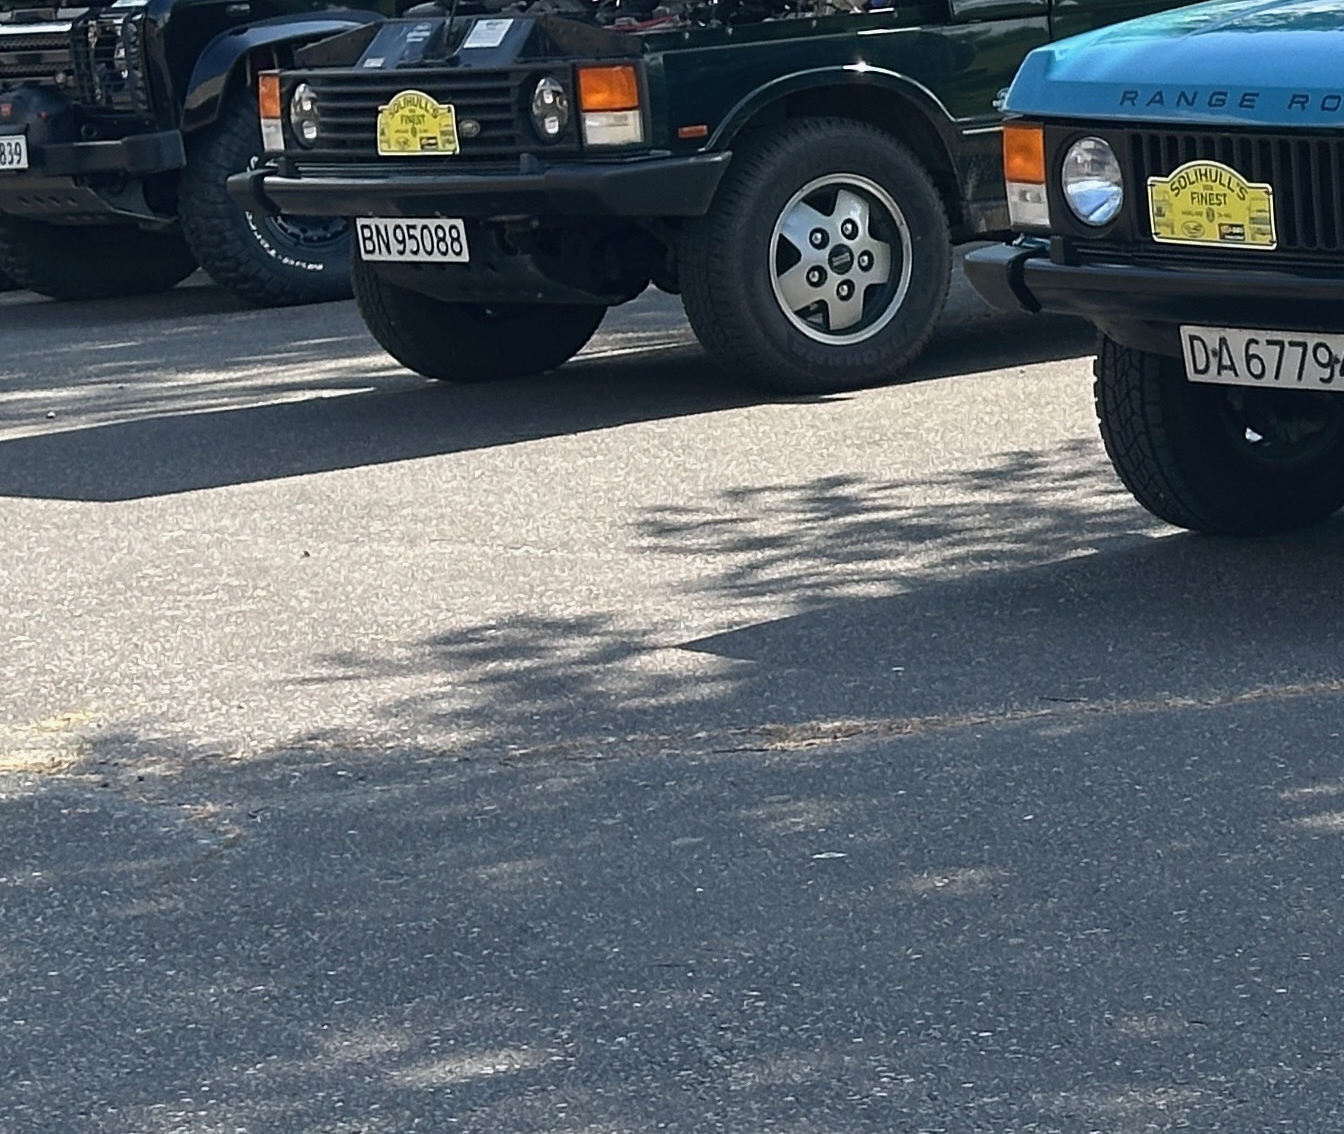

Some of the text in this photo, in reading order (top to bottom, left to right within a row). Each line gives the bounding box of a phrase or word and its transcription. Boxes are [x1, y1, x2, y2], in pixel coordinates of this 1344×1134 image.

[1119, 90, 1260, 110] RANGE
[1170, 167, 1248, 201] SOLIHULL'S
[1190, 191, 1227, 206] FINEST
